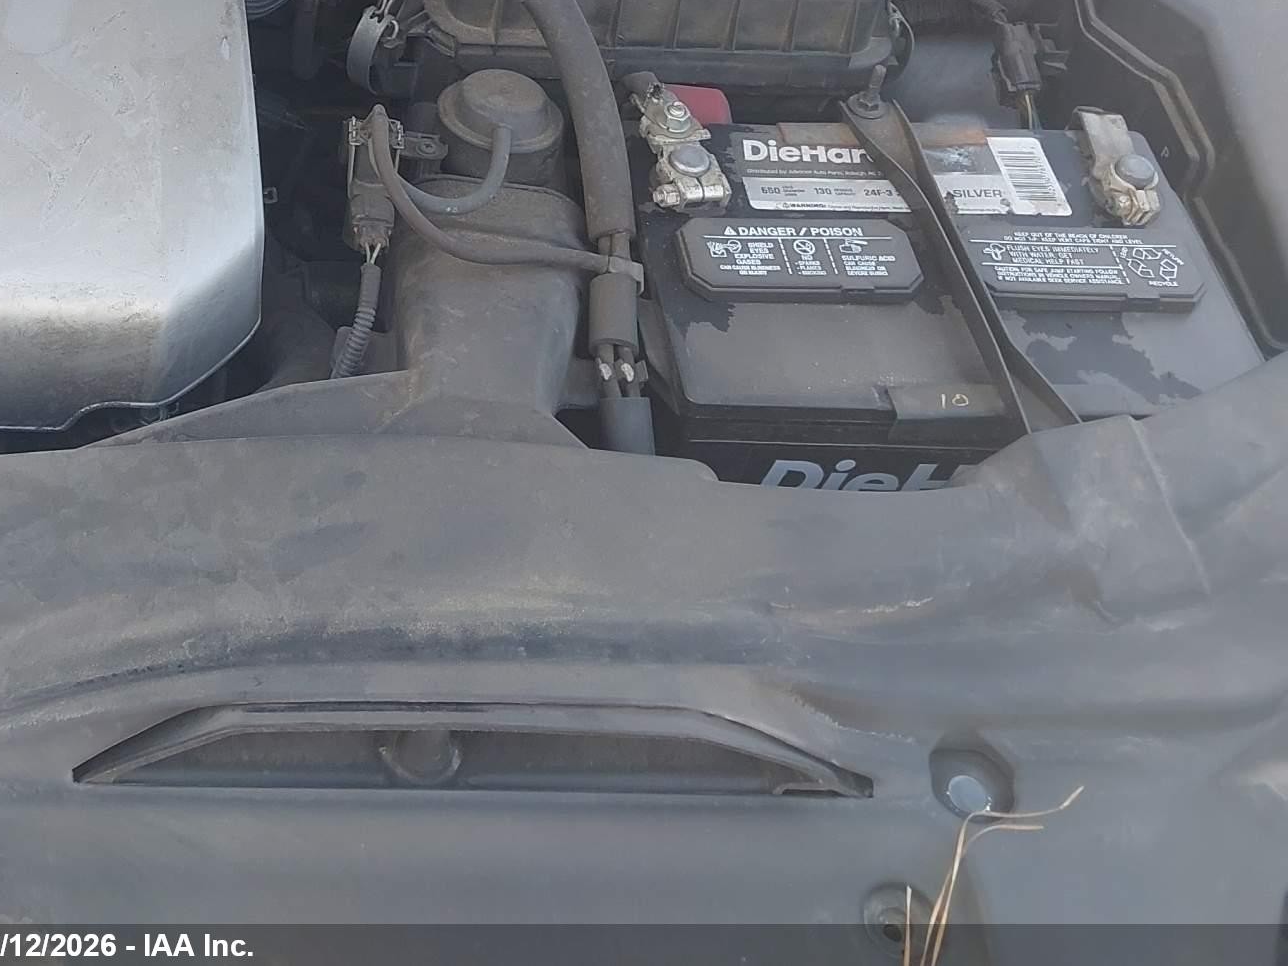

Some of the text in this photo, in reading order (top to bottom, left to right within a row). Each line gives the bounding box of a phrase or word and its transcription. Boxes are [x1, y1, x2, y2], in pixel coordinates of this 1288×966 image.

[953, 189, 1002, 199] SILVER
[738, 226, 797, 237] DANGER
[810, 227, 864, 237] POISON
[1006, 244, 1030, 252] FLUSH
[1008, 251, 1028, 259] WITH
[1011, 257, 1045, 265] MEDICAL
